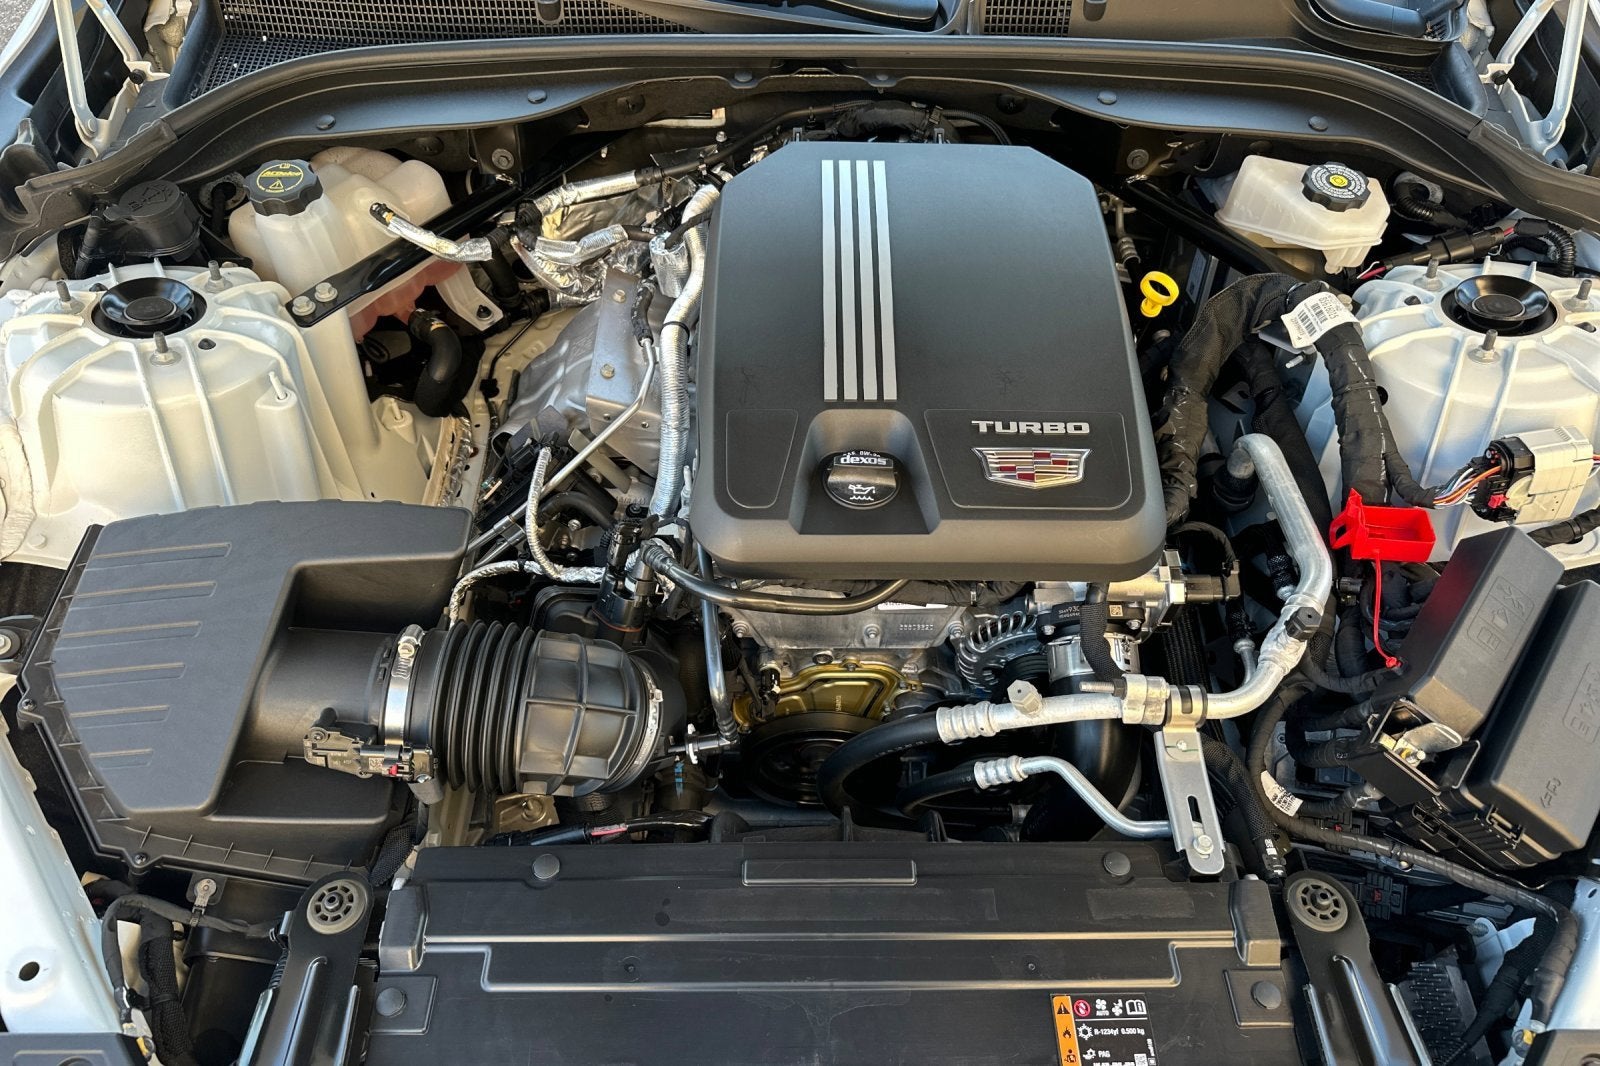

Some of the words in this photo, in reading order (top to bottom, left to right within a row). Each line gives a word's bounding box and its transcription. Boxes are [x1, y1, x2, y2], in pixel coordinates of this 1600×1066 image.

[971, 420, 1090, 435] TURBO
[840, 454, 887, 465] dexos
[1094, 1028, 1119, 1036] R-1234yf
[1137, 1027, 1145, 1036] kg
[1097, 1050, 1111, 1058] PAG
